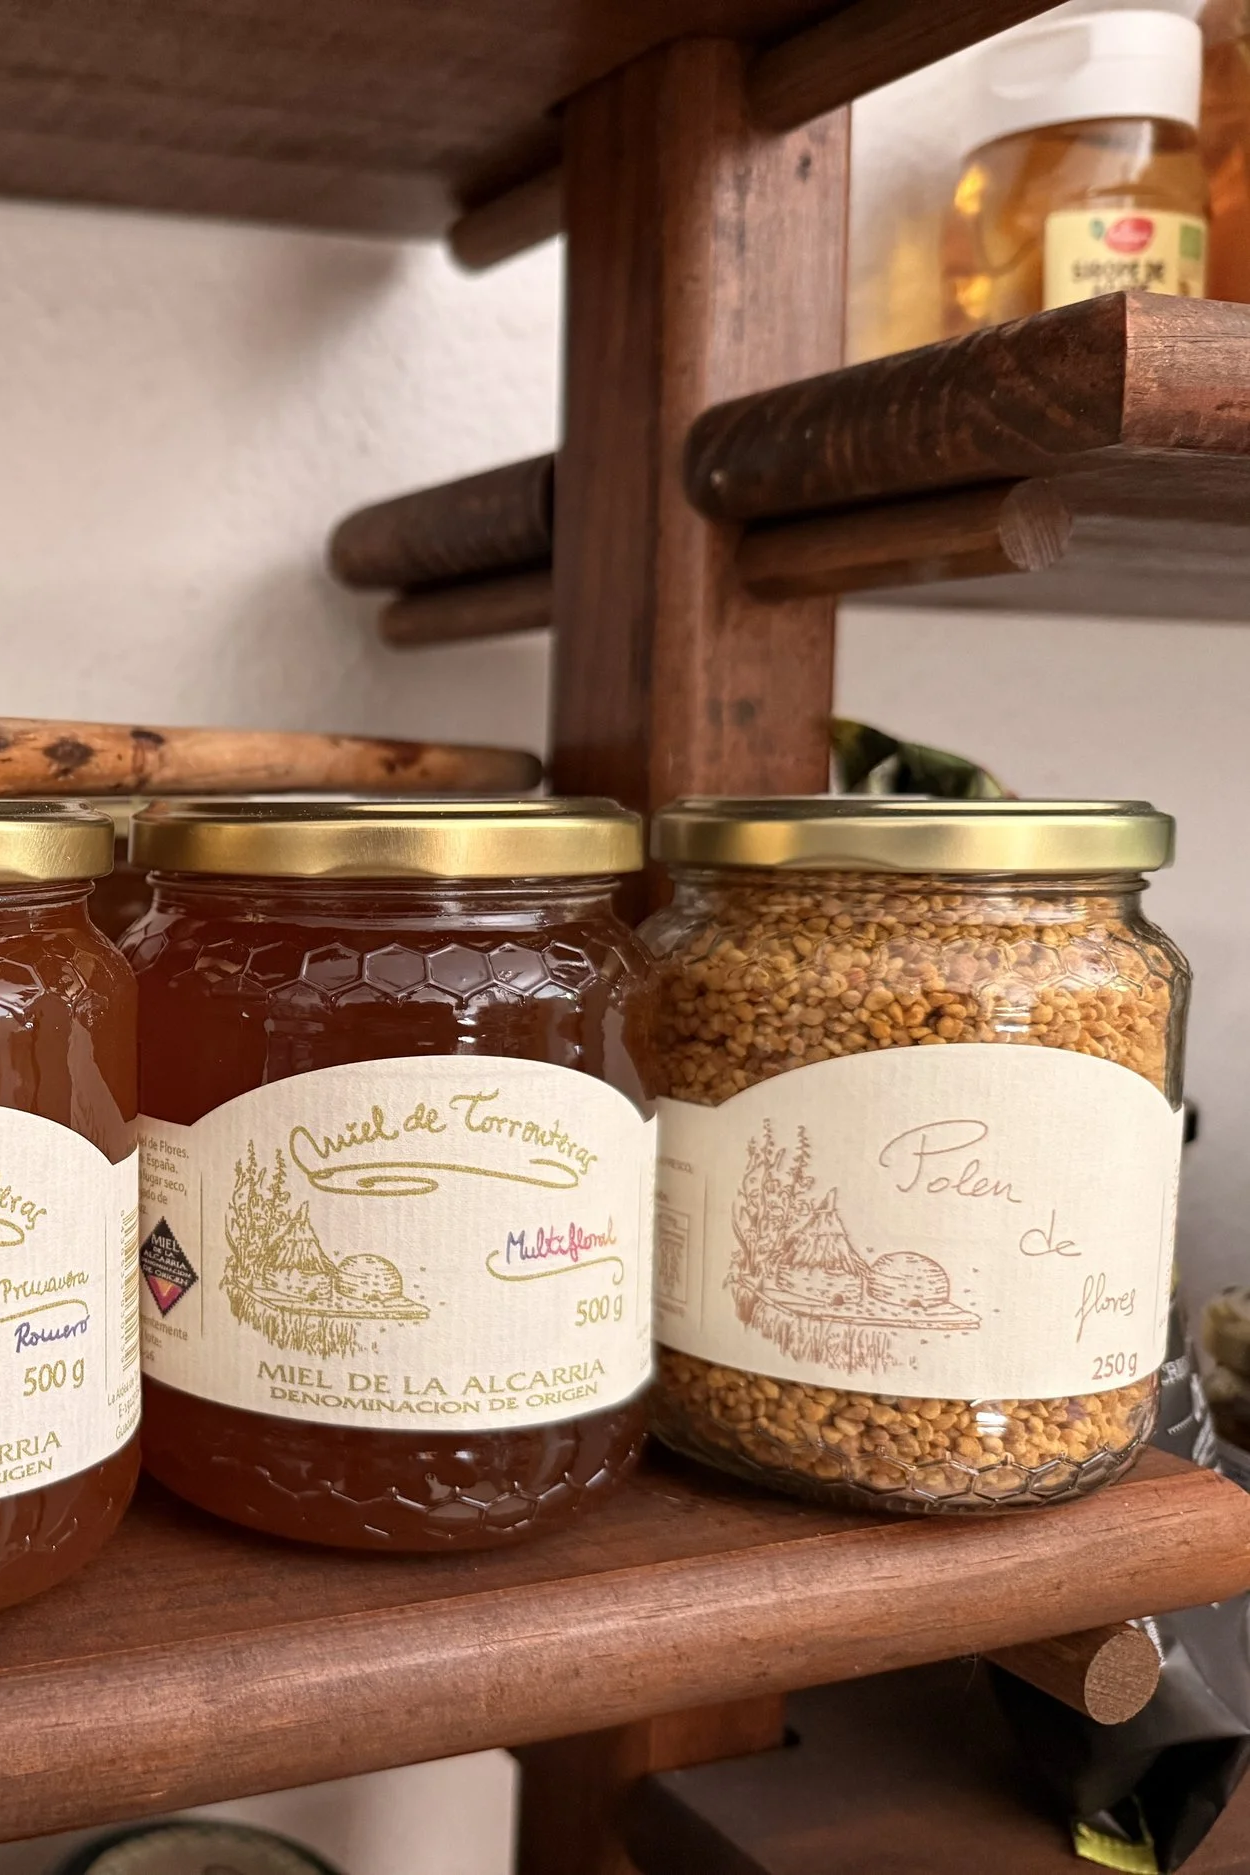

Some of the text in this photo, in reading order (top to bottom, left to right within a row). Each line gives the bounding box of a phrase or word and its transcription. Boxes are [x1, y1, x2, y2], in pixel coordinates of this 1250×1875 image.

[148, 1136, 157, 1151] de
[159, 1140, 190, 1159] Flores.
[289, 1105, 399, 1162] Miel
[402, 1102, 447, 1133] de
[146, 1153, 178, 1174] España.
[879, 1119, 1022, 1203] Polen
[157, 1191, 168, 1205] de
[163, 1178, 187, 1197] seco,
[151, 1233, 180, 1253] MIEL
[505, 1215, 618, 1265] Multifloral
[1019, 1210, 1081, 1257] de
[143, 1249, 188, 1271] ALCARRIA
[152, 1246, 175, 1259] DE LA
[154, 1269, 189, 1287] ORIGEN
[575, 1296, 612, 1328] 500
[613, 1292, 623, 1323] g
[1075, 1273, 1136, 1342] flores
[15, 1314, 89, 1354] Romero
[23, 1356, 85, 1397] 500 g
[256, 1357, 605, 1396] MIEL DE LA ALCARRIA
[1090, 1356, 1127, 1380] 250
[1127, 1353, 1137, 1377] g
[269, 1380, 598, 1413] DENOMINACION DE ORIGEN
